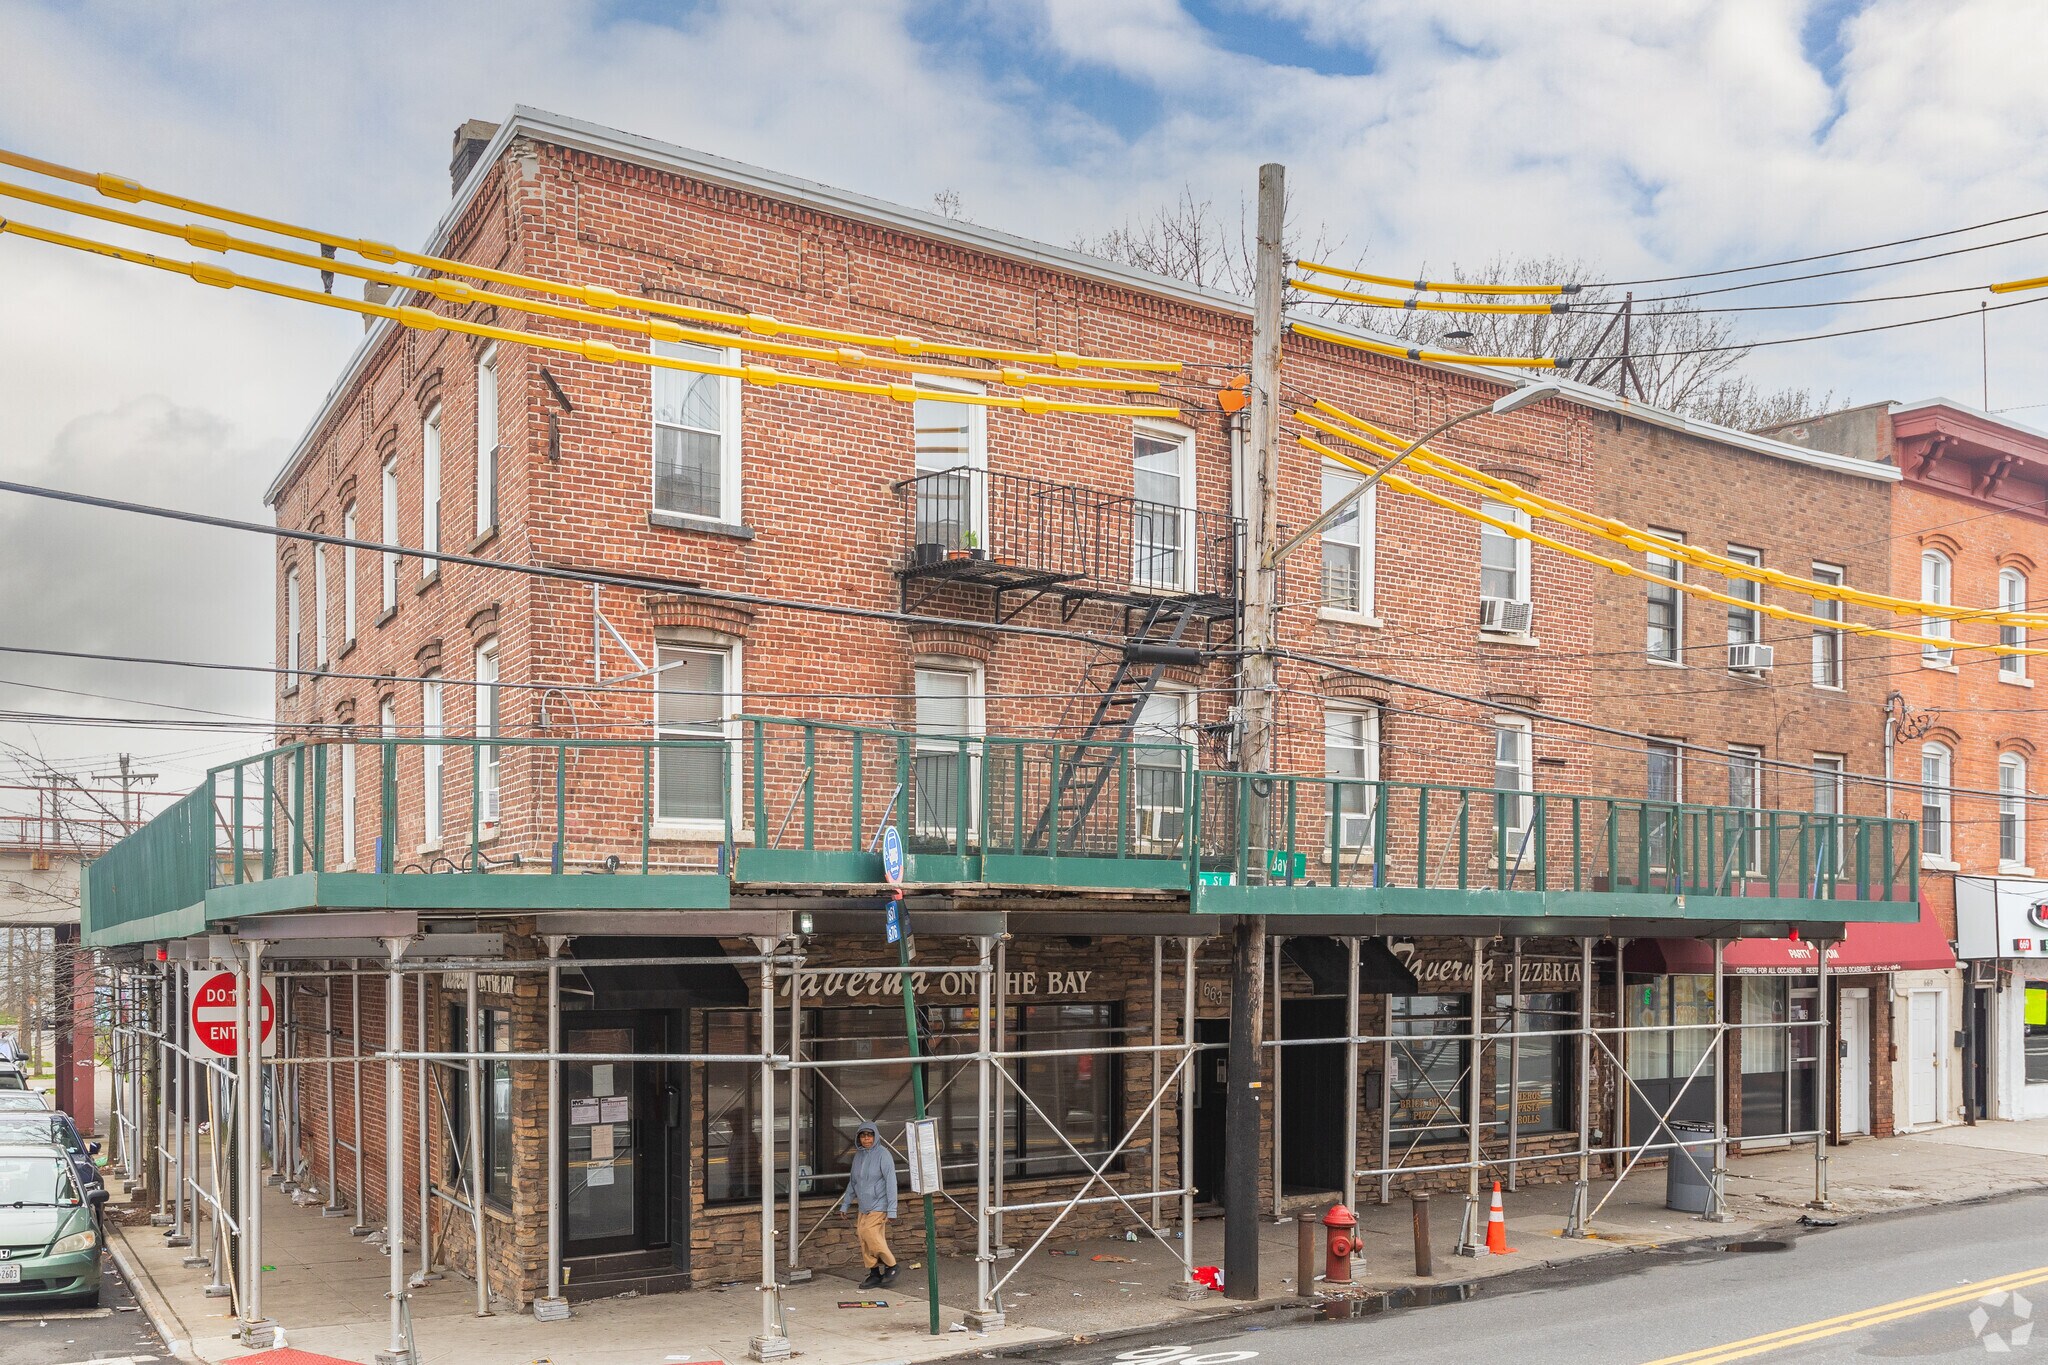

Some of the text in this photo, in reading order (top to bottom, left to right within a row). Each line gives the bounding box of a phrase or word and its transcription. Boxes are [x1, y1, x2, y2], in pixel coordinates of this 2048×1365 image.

[1788, 949, 1811, 958] PARTY
[1503, 962, 1582, 983] PZZERIA
[940, 972, 976, 996] ON
[1047, 970, 1092, 995] BAY
[206, 988, 226, 1002] DO
[1204, 981, 1223, 1005] 663
[1413, 1110, 1437, 1121] PIZZ
[1517, 1115, 1541, 1125] ROLLS
